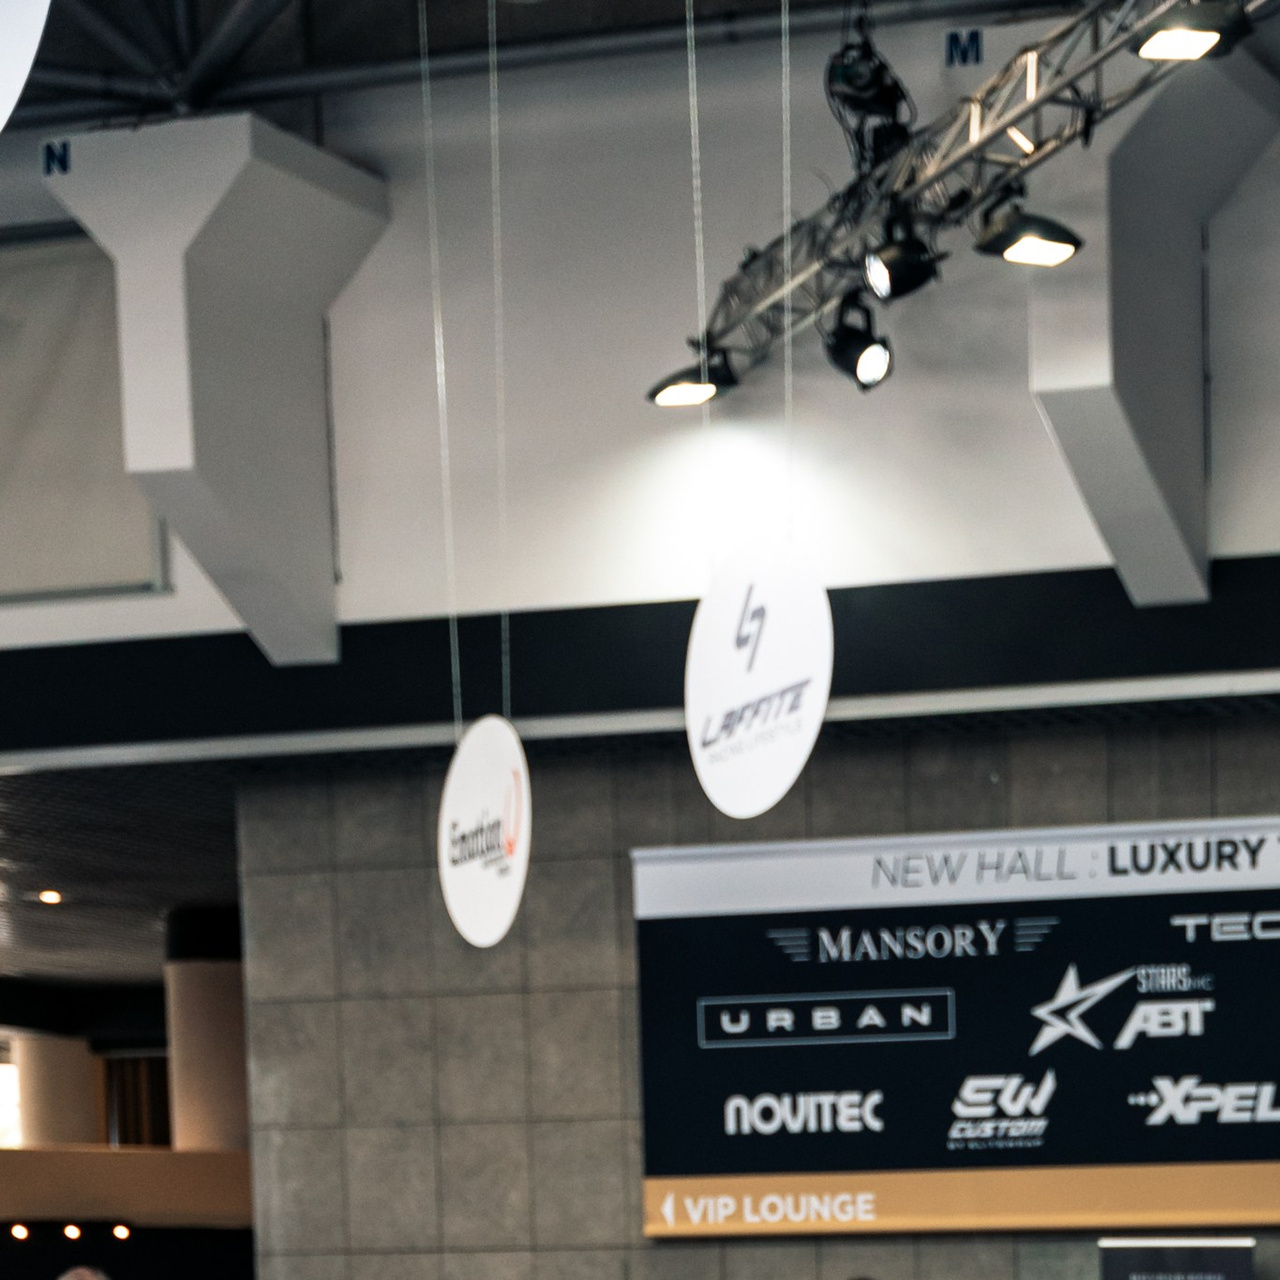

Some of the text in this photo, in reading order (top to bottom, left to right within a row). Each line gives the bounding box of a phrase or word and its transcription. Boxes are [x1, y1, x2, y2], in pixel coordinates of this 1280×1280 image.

[946, 30, 983, 68] M
[43, 142, 71, 176] N
[871, 851, 967, 888] NEW
[976, 846, 1077, 884] HALL
[1109, 837, 1265, 876] LUXURY
[818, 919, 1005, 963] MANSORY
[720, 1004, 932, 1033] URBAN
[1113, 999, 1216, 1050] ABT
[684, 1193, 876, 1223] VIP LOUNGE
